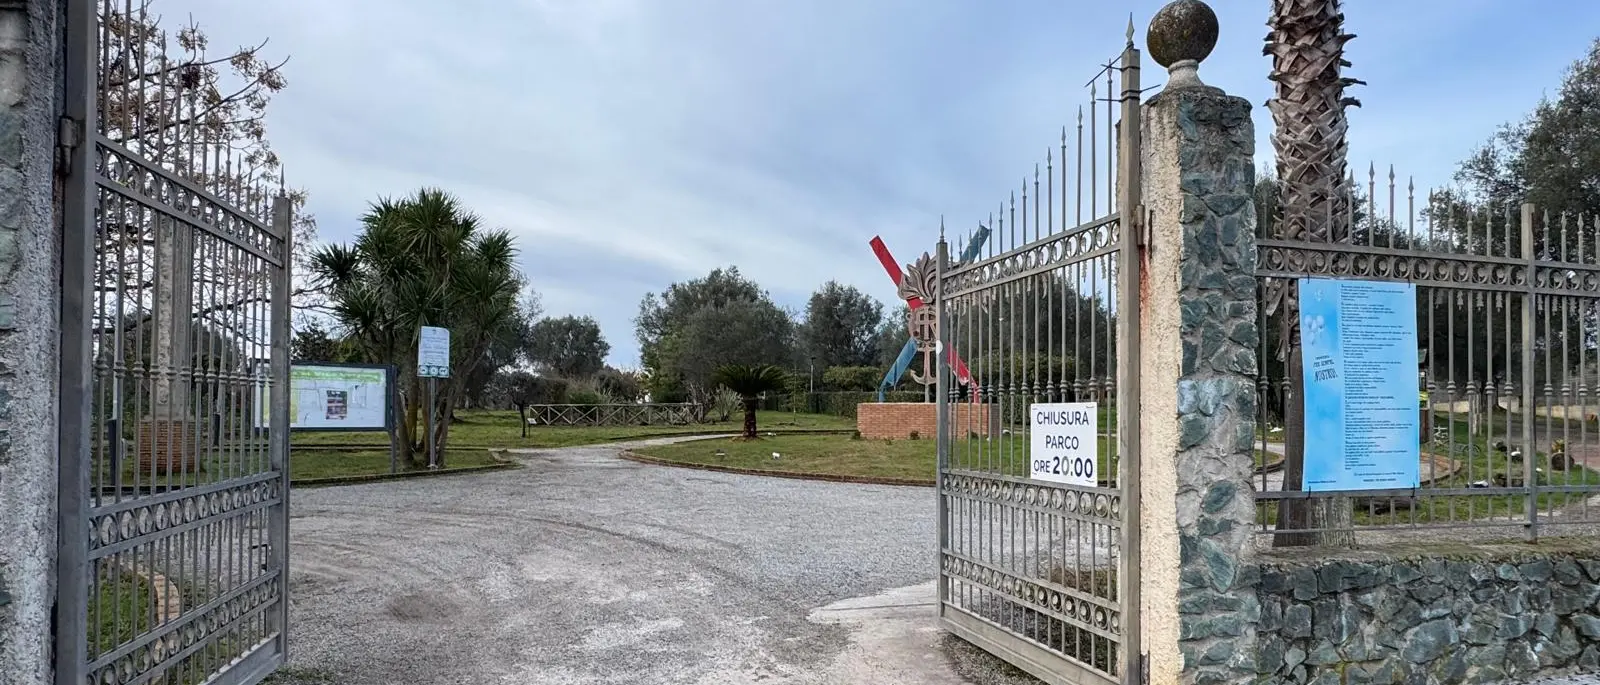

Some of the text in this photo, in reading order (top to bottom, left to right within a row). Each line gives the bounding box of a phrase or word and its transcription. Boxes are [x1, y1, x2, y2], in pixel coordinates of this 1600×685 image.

[1037, 411, 1089, 425] CHIUSURA
[1045, 435, 1079, 450] PARCO
[1034, 456, 1093, 477] ORE 20:00
